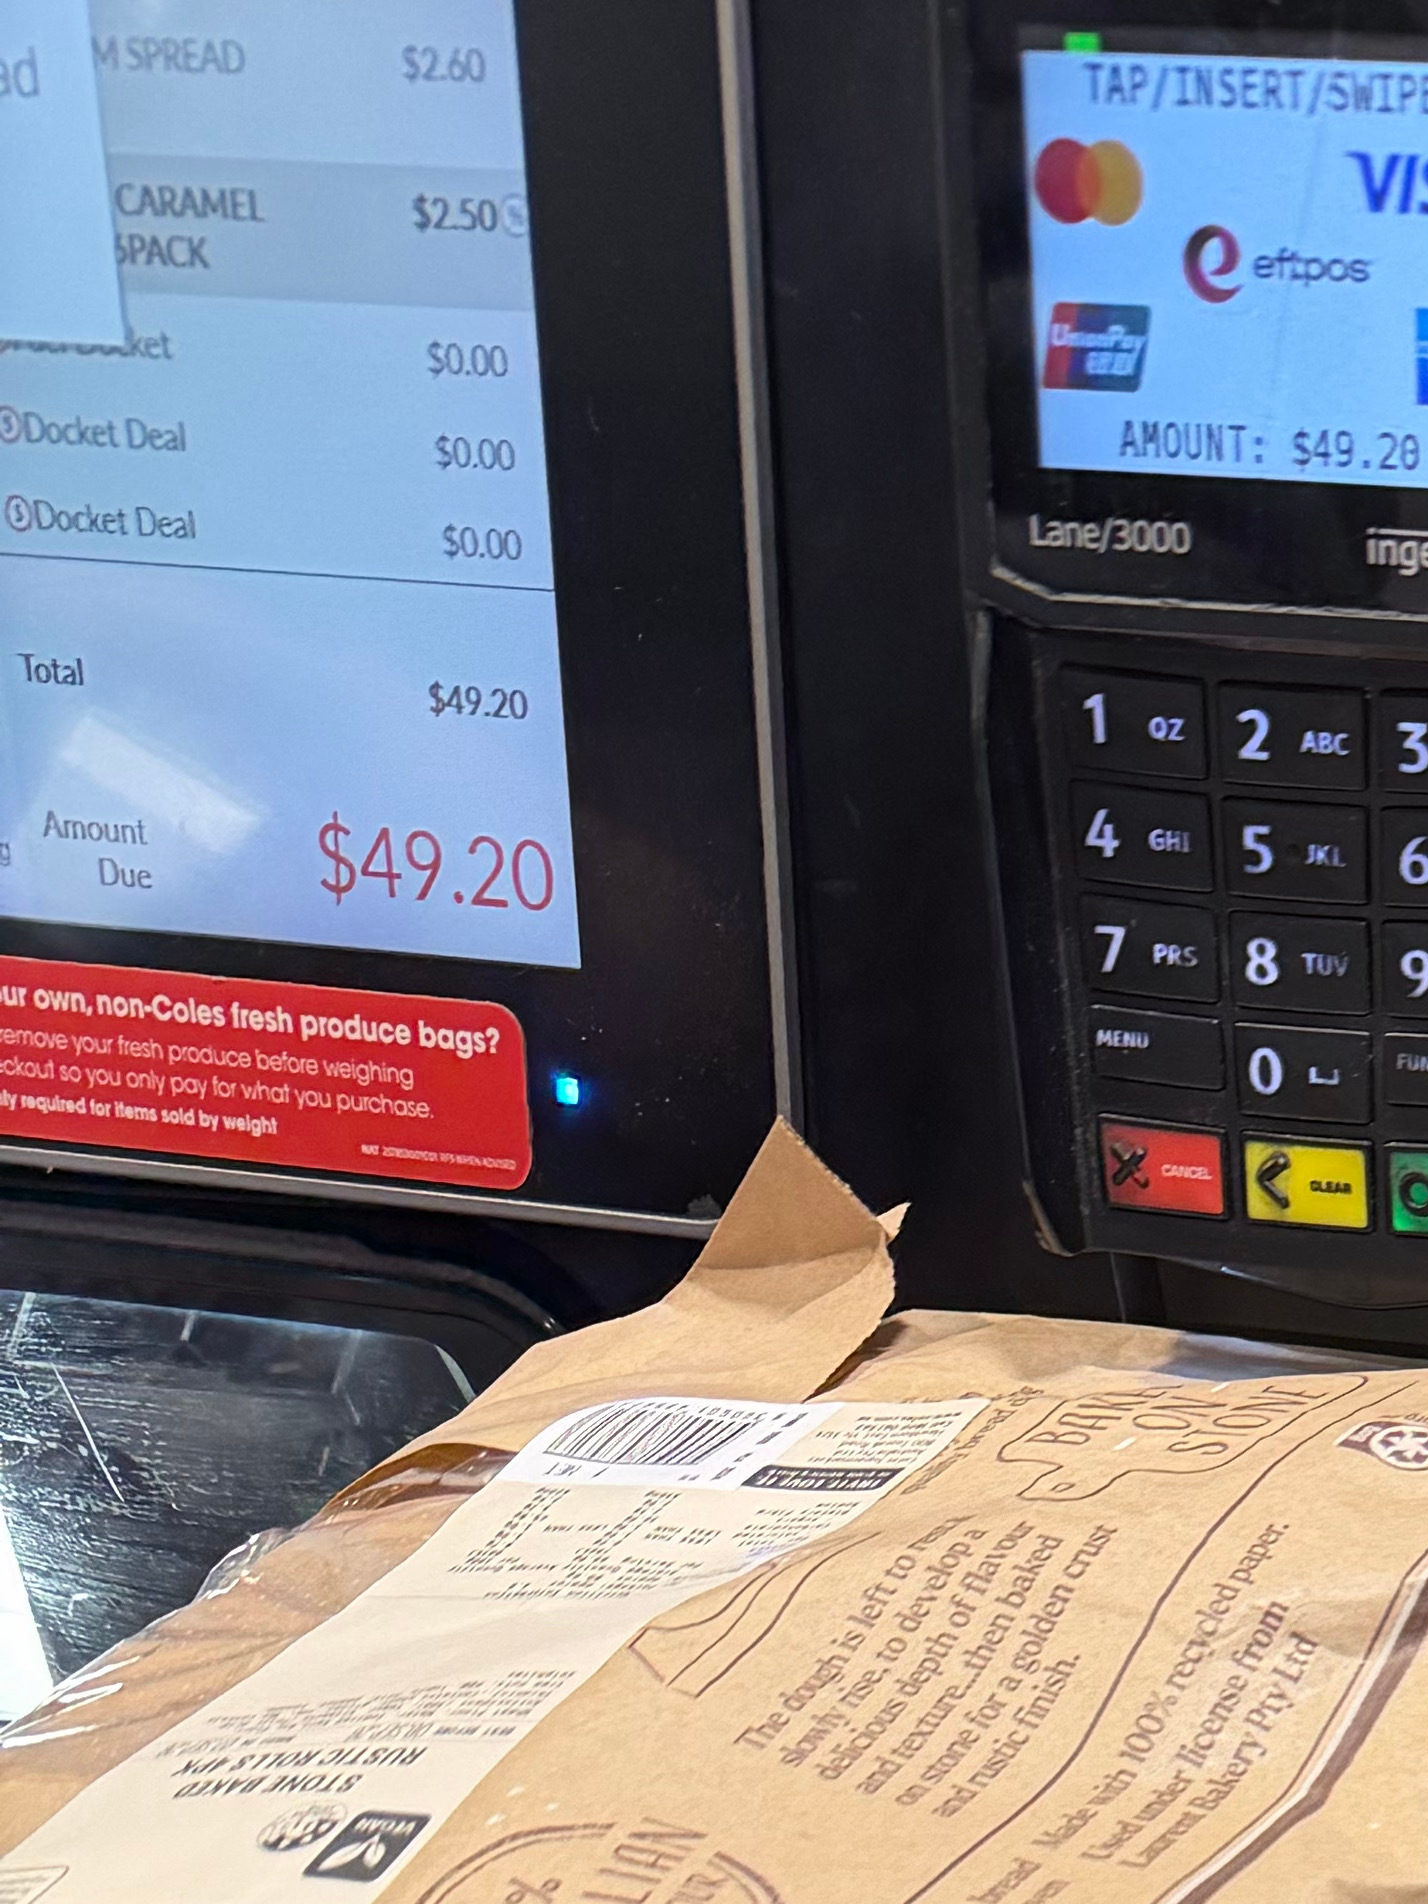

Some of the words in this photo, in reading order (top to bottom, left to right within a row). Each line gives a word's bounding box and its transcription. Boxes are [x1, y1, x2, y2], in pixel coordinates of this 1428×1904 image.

[127, 38, 246, 75] SPREAD
[402, 43, 485, 83] $2.60
[114, 182, 266, 224] CARAMEL
[412, 193, 498, 233] $2.50
[1252, 247, 1372, 288] eftpos
[427, 341, 508, 378] $0.00
[23, 411, 117, 449] Docket
[127, 417, 187, 453] Deal
[1119, 419, 1264, 464] AMOUNT:
[1292, 429, 1421, 471] $49.20
[435, 435, 516, 472] $0.00
[36, 499, 128, 537] Docket
[135, 506, 196, 540] Deal
[1028, 514, 1192, 555] Lane/3000
[443, 522, 522, 561] $0.00
[17, 652, 84, 687] Total
[428, 680, 528, 720] $49.20
[1082, 693, 1107, 744] 1
[1149, 716, 1185, 742] QZ
[1236, 708, 1271, 761] 2
[1300, 731, 1350, 756] ABC
[43, 809, 148, 847] Amount
[1084, 808, 1120, 858] 4
[1148, 828, 1190, 853] GHI
[98, 857, 153, 890] Due
[318, 810, 553, 911] $49.20
[1242, 825, 1273, 874] 5
[1304, 844, 1347, 868] JKL
[1094, 924, 1126, 973] 7
[1152, 943, 1198, 968] PRS
[1246, 936, 1279, 986] 8
[1301, 952, 1348, 976] TUV
[33, 987, 93, 1019] own,
[95, 992, 226, 1028] non-Coles
[231, 1001, 293, 1035] fresh
[301, 1011, 411, 1045] produce
[418, 1020, 500, 1059] bags?
[1096, 1029, 1149, 1049] MENU
[1249, 1047, 1283, 1095] 0
[1161, 1163, 1212, 1180] CANCEL
[1310, 1180, 1352, 1195] CLEAR
